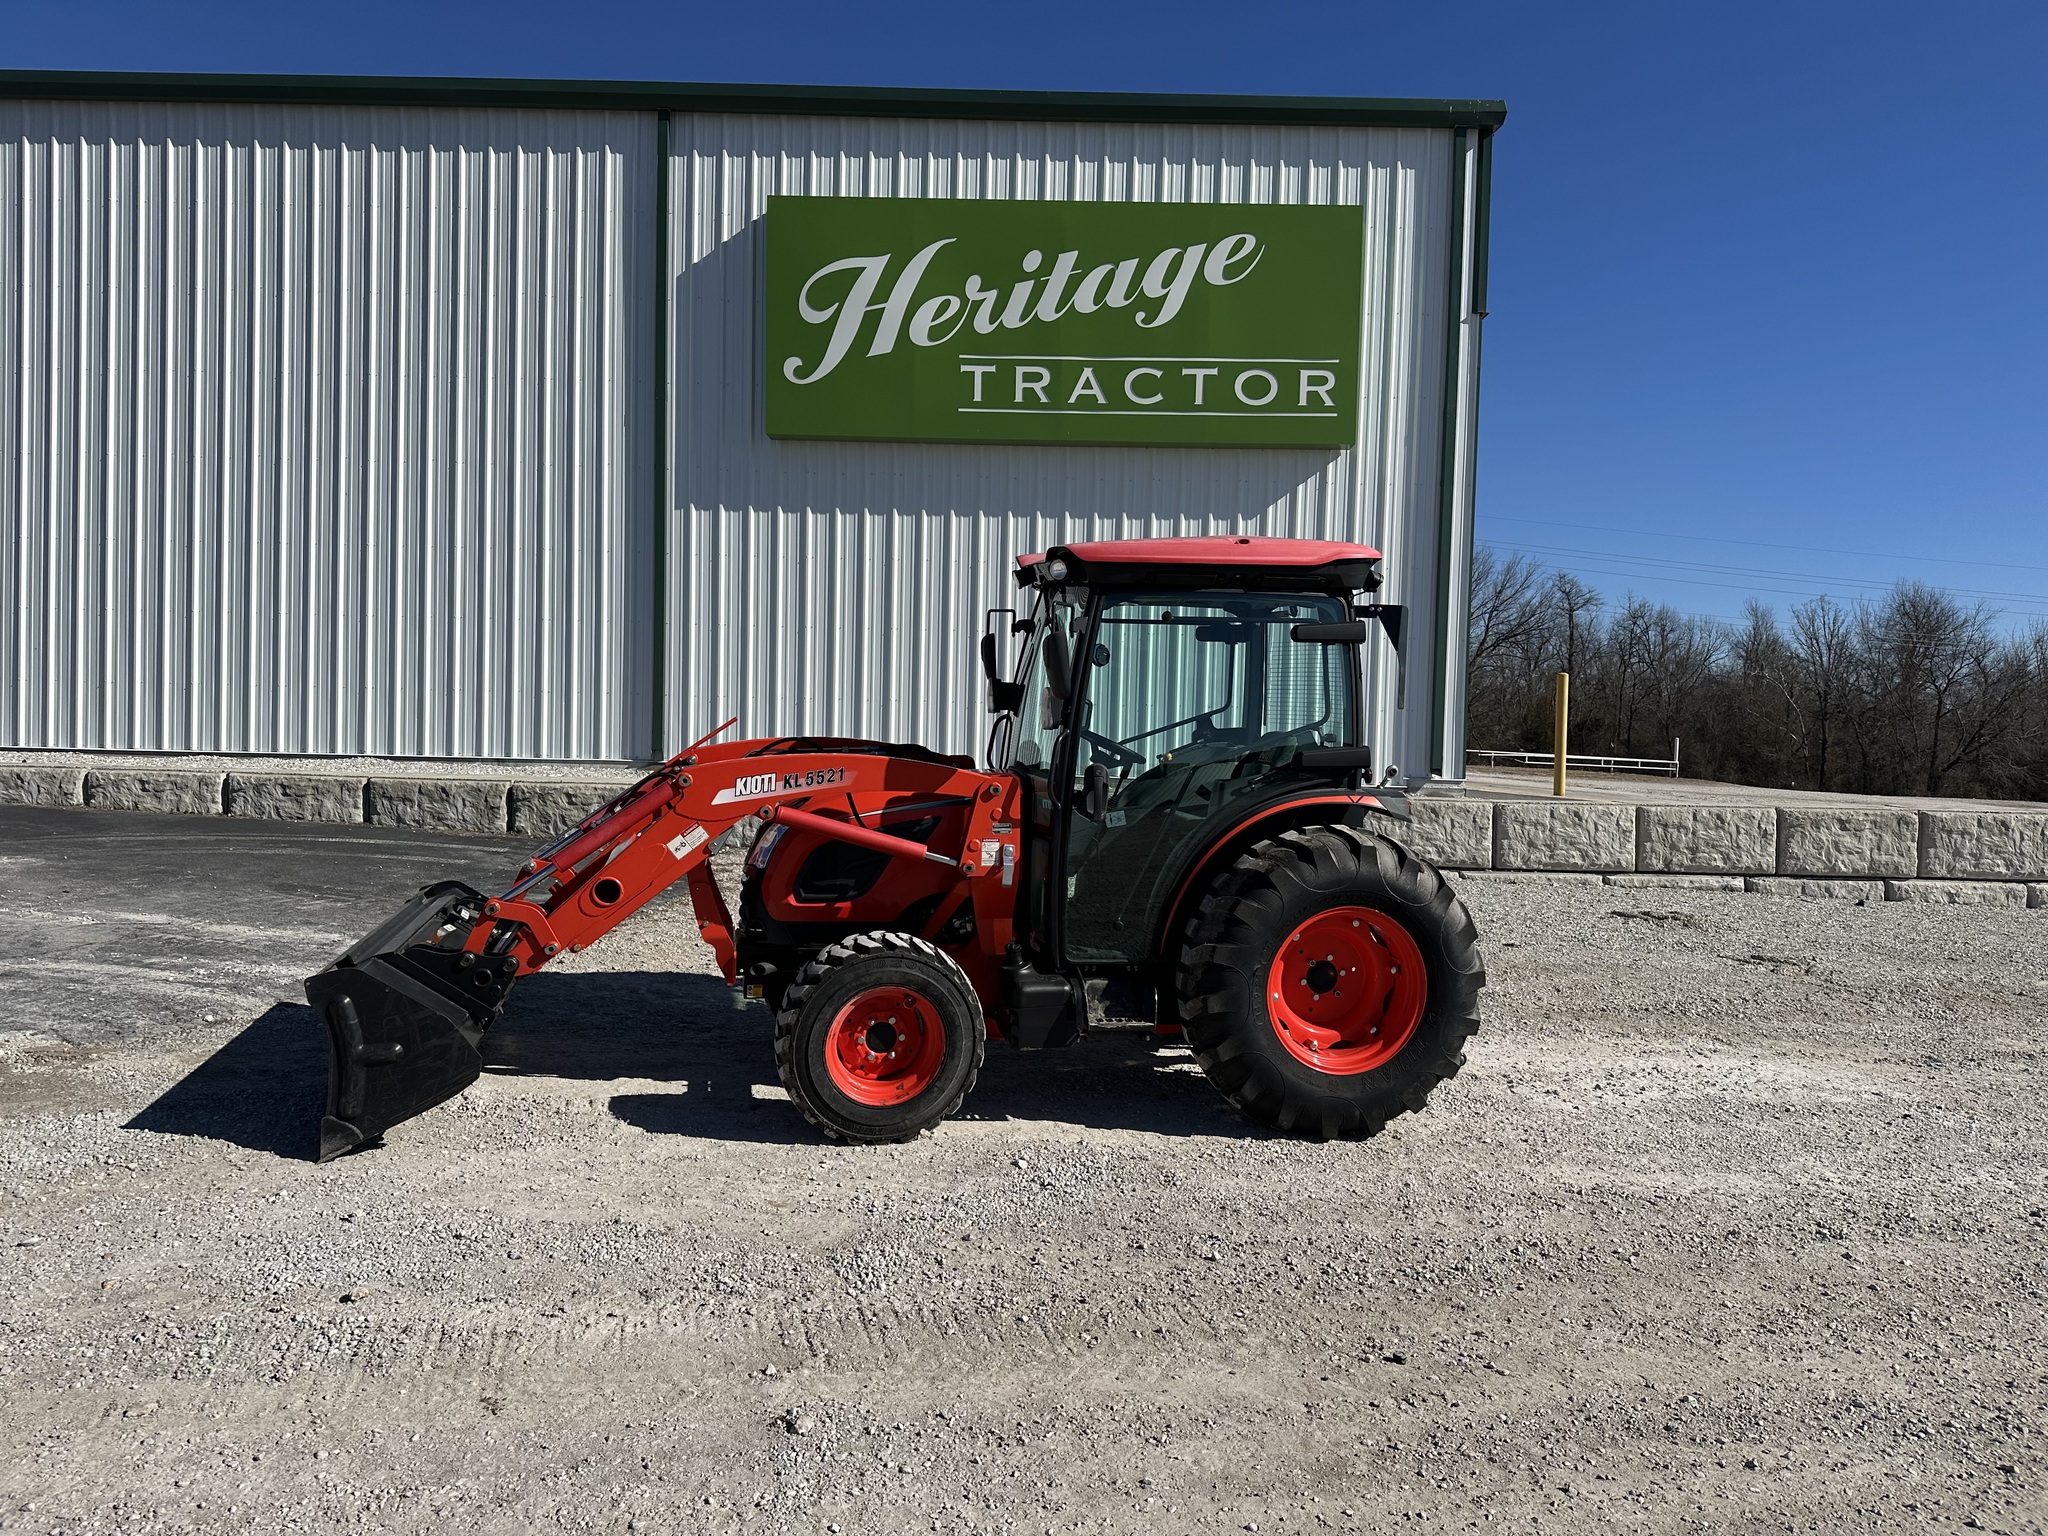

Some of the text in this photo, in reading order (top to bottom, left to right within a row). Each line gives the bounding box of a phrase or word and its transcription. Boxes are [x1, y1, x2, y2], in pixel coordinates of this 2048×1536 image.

[782, 232, 1266, 386] Heritage
[960, 363, 1337, 407] TRACTOR
[735, 767, 845, 797] KIOTI KL 5521
[1360, 1038, 1431, 1094] TITAN
